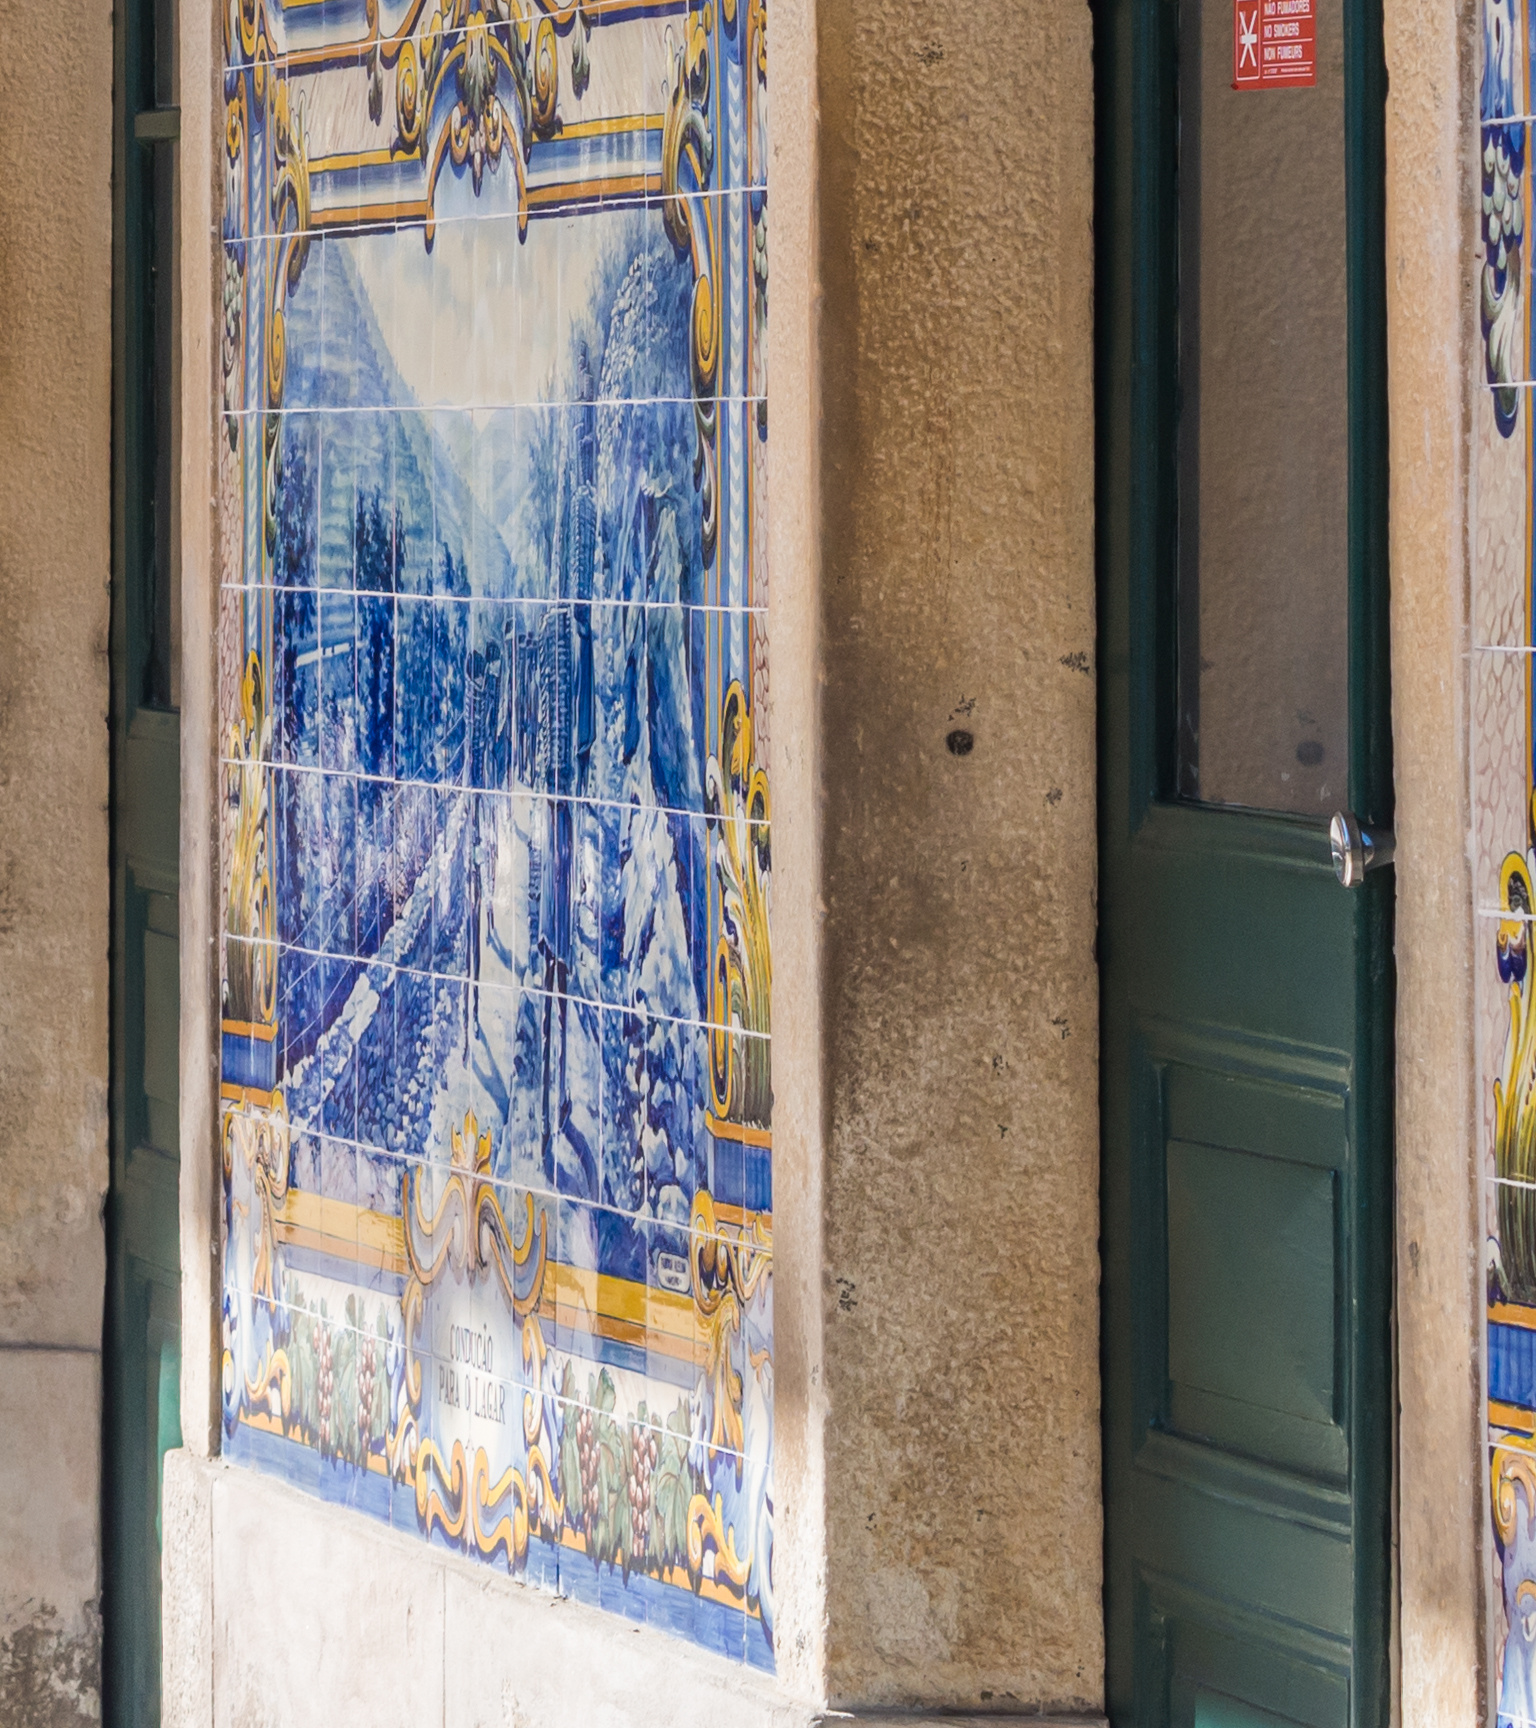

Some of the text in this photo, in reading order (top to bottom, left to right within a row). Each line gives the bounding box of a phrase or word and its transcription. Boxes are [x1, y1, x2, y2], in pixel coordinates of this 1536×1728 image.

[439, 1364, 506, 1425] PARA O LAGAR
